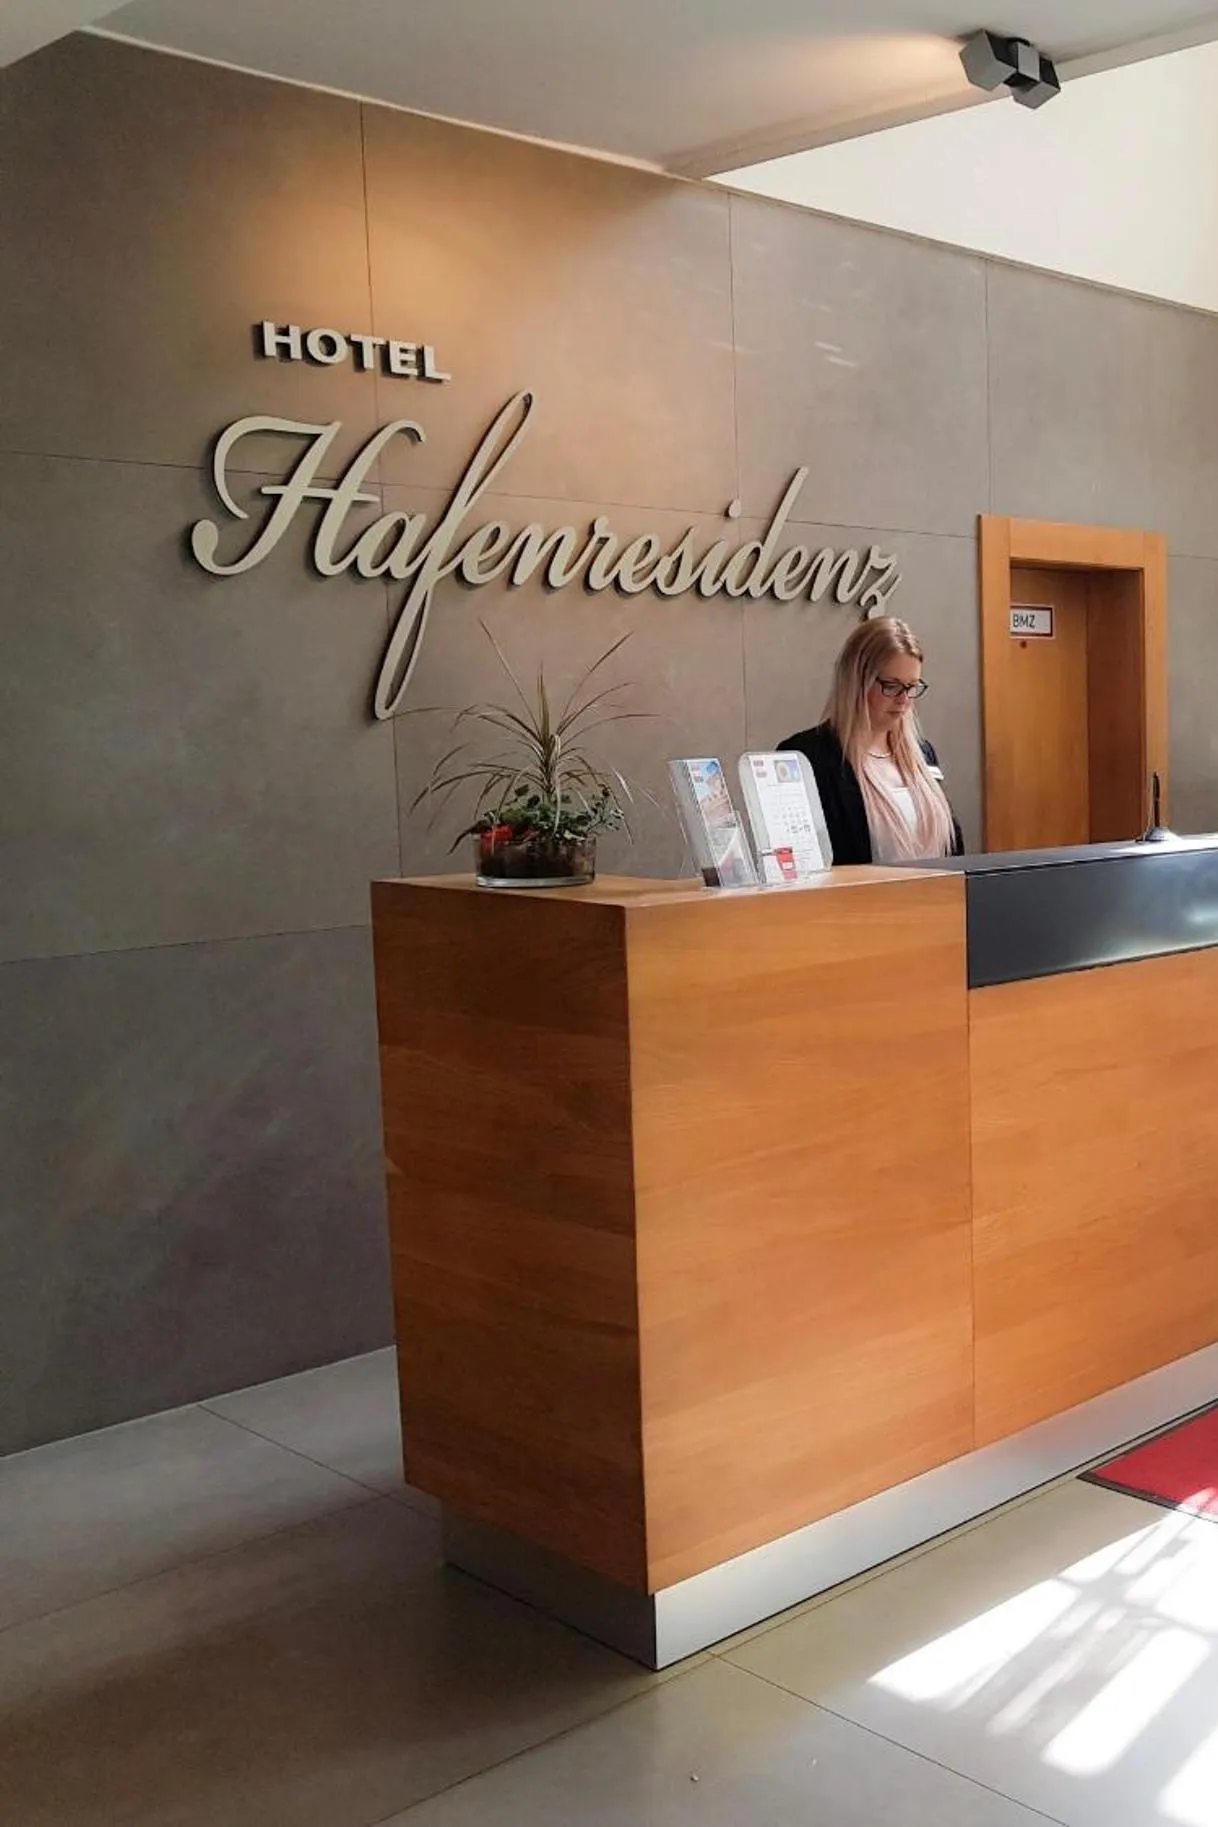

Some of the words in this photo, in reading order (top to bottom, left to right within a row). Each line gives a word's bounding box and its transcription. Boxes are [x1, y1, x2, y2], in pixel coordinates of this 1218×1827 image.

[261, 319, 452, 382] HOTEL
[191, 390, 902, 720] Hafenresidenz
[1012, 613, 1036, 629] BMZ
